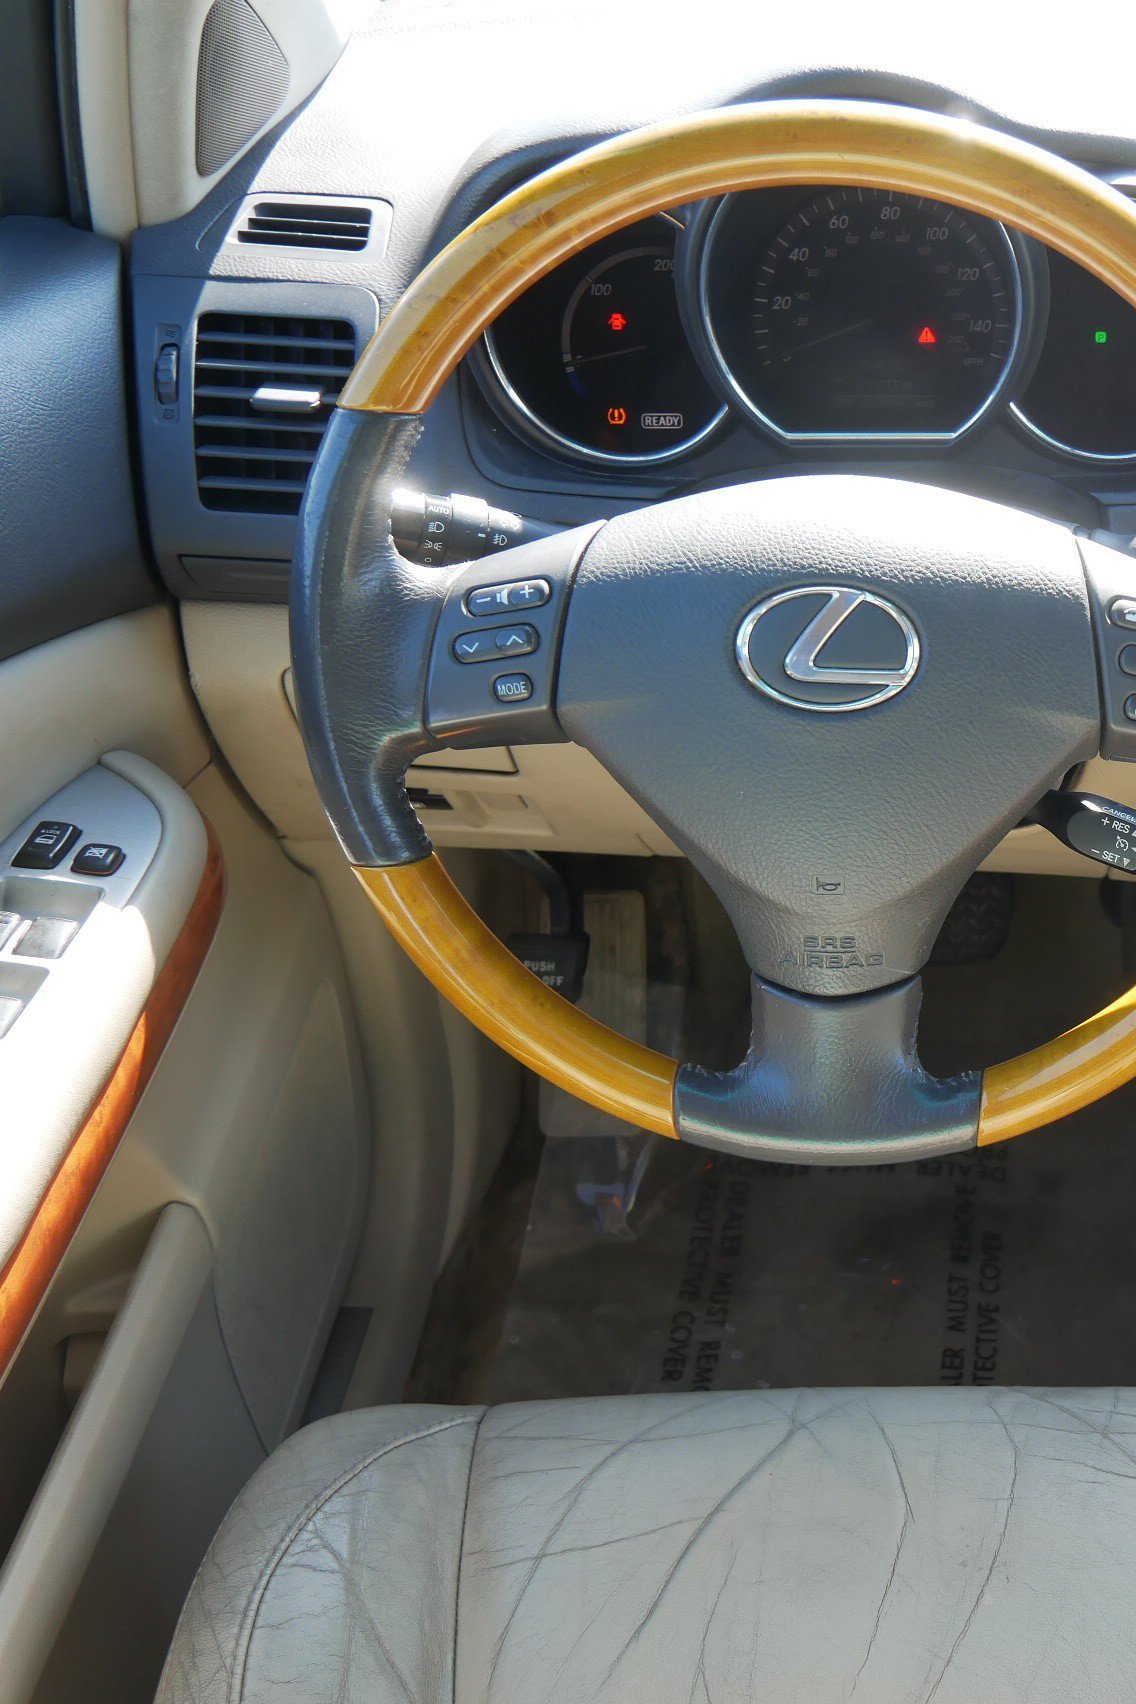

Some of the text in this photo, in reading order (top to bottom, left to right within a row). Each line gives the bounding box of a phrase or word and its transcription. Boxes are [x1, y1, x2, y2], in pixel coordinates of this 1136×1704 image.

[880, 206, 901, 220] 80
[828, 215, 850, 229] 60
[924, 226, 949, 241] 100
[788, 247, 810, 262] 40
[956, 267, 980, 281] 120
[589, 283, 613, 297] 100
[771, 295, 793, 311] 20
[969, 319, 992, 333] 140
[644, 415, 681, 427] READY
[427, 504, 450, 516] AUTO
[496, 681, 528, 697] MODE
[1111, 820, 1131, 834] RES
[1101, 850, 1121, 864] SET
[803, 934, 857, 949] SRS
[524, 959, 556, 972] PUSH
[778, 953, 885, 969] AIRBAG
[943, 1272, 971, 1334] MUST
[972, 1230, 1004, 1386] TECTIVE COVER
[659, 1310, 697, 1385] COVER
